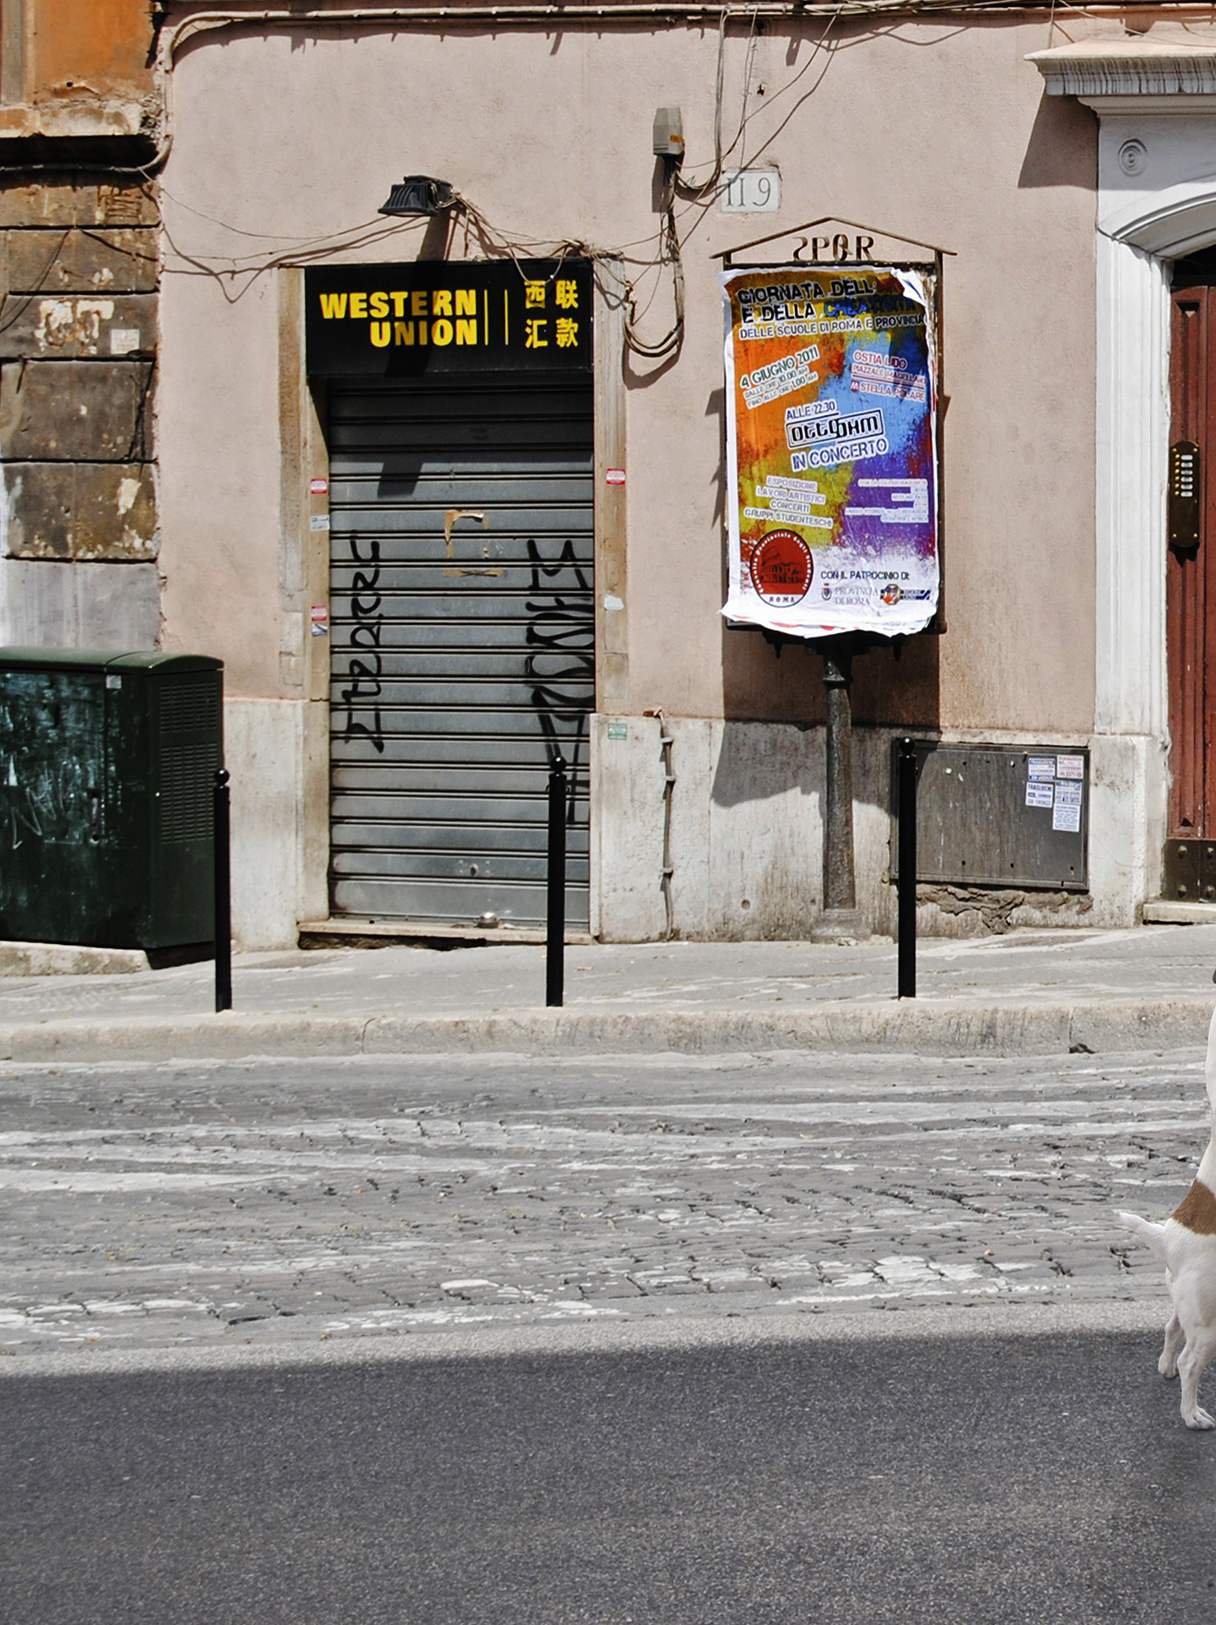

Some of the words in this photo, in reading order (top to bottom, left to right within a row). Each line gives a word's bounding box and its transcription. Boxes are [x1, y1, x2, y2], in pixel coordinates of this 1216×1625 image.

[726, 177, 771, 207] 119
[524, 280, 579, 309] 西联
[738, 282, 825, 304] GIORNATA
[319, 289, 477, 319] WESTERN
[742, 306, 754, 323] E
[762, 302, 816, 322] DELLA
[370, 319, 478, 348] UNION
[524, 317, 579, 349] 汇款
[740, 325, 774, 339] DELLE
[777, 322, 817, 336] SCUOLE
[832, 319, 862, 332] ROMA
[866, 319, 874, 329] E
[876, 315, 925, 328] PROVINCIA
[741, 377, 749, 388] 4
[752, 357, 796, 384] GIUGNO
[797, 346, 819, 365] 2011
[854, 351, 882, 365] OSTIA
[885, 356, 908, 369] LIDO
[861, 383, 892, 395] STELLA
[786, 406, 811, 421] ALLE
[792, 454, 806, 470] IN
[809, 438, 887, 465] CONCERTO
[757, 487, 787, 498] LAVORI
[767, 476, 817, 491] ESPOSIZIONE
[744, 508, 774, 519] GRUPPI
[771, 500, 810, 512] CONCERTI
[820, 570, 839, 580] CON
[850, 570, 900, 580] PATROCINIO
